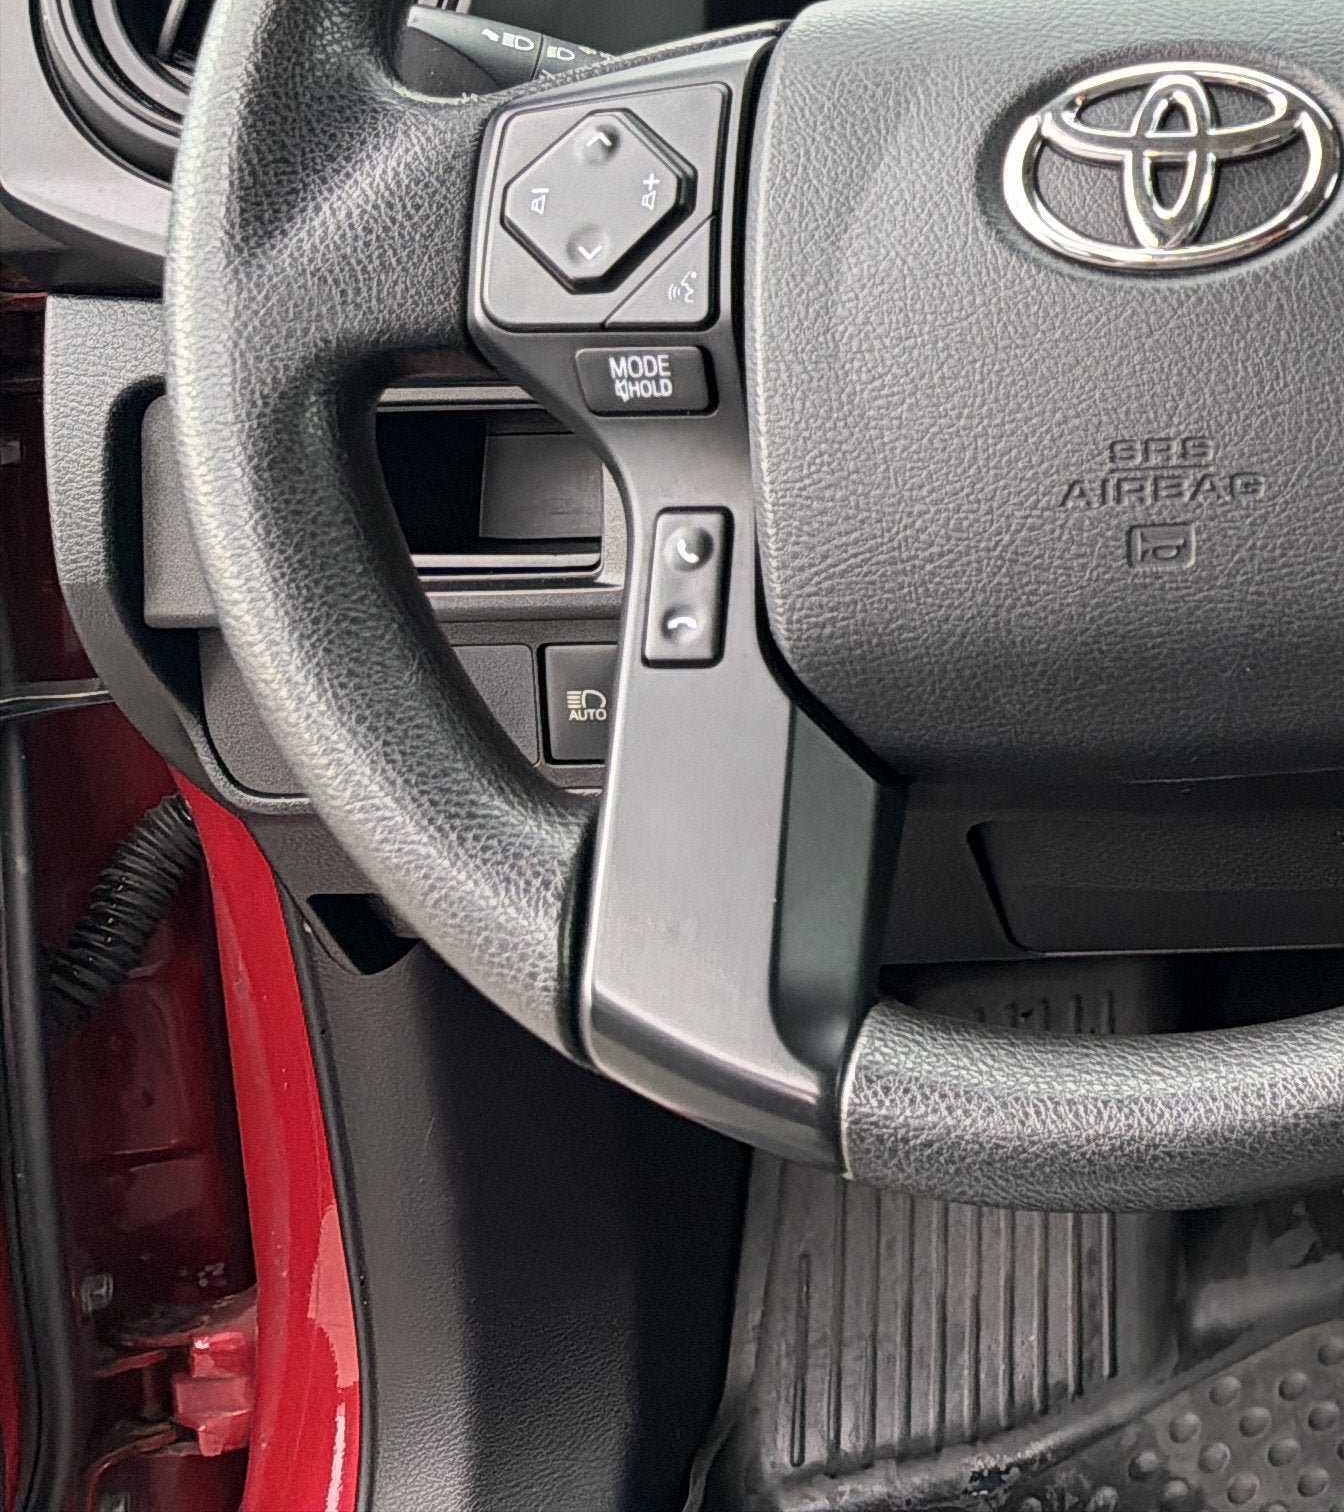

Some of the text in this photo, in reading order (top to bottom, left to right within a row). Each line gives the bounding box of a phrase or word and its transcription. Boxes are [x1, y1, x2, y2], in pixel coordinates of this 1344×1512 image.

[608, 353, 671, 380] MODE
[629, 378, 673, 398] HOLD
[1107, 436, 1216, 465] SRS
[1057, 470, 1267, 508] AIRBAG
[568, 708, 608, 721] AUTO
